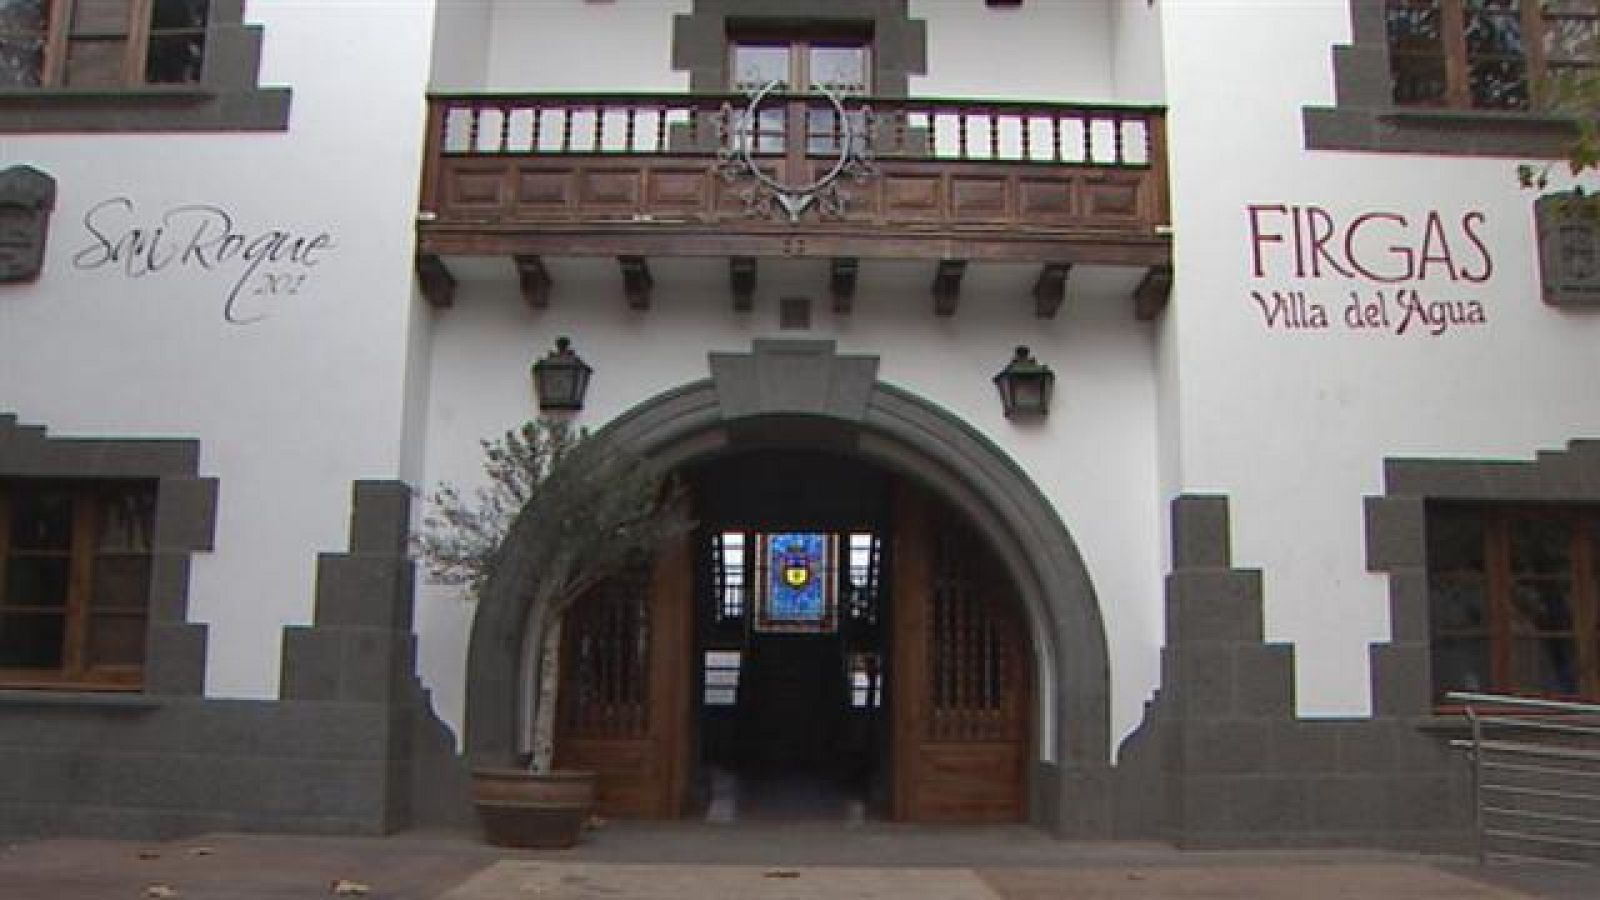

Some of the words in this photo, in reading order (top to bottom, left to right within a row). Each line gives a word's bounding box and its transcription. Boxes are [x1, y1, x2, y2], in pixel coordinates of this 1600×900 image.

[163, 204, 332, 324] Roque
[1246, 204, 1493, 282] FIRGAS
[1250, 290, 1328, 328] Villa
[1344, 289, 1389, 328] del
[1395, 289, 1486, 335] Agua
